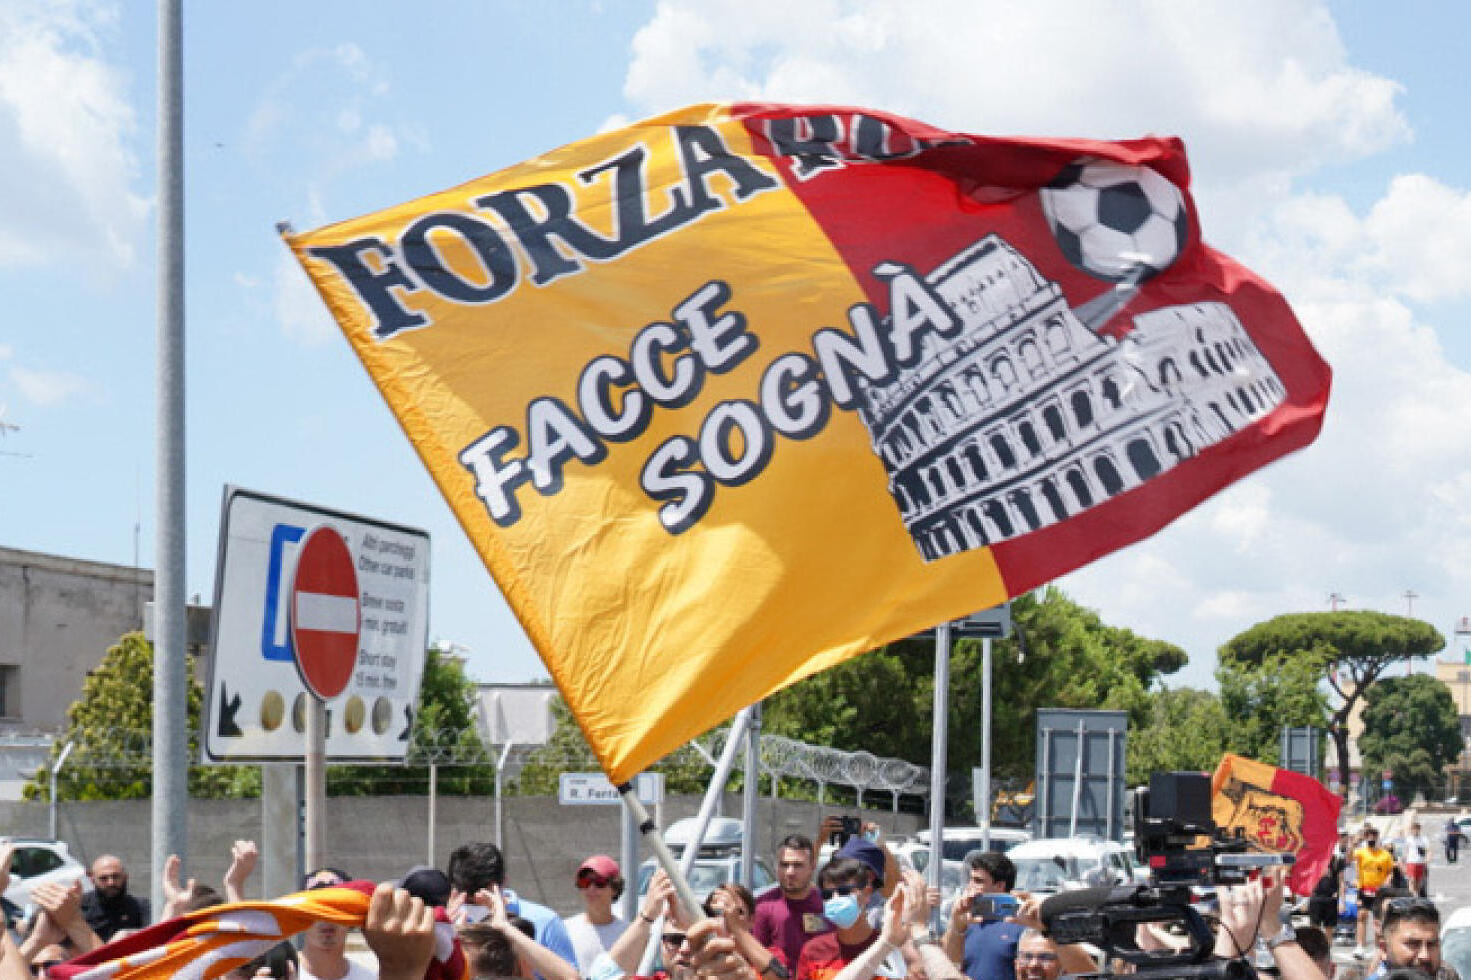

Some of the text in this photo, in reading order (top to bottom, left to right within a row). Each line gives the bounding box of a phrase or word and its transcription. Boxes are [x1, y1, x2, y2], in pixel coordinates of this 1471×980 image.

[309, 123, 783, 341] FORZA
[456, 280, 762, 529] FACCE
[639, 260, 966, 534] SOGNÀ
[359, 554, 379, 572] Other
[381, 563, 393, 576] car
